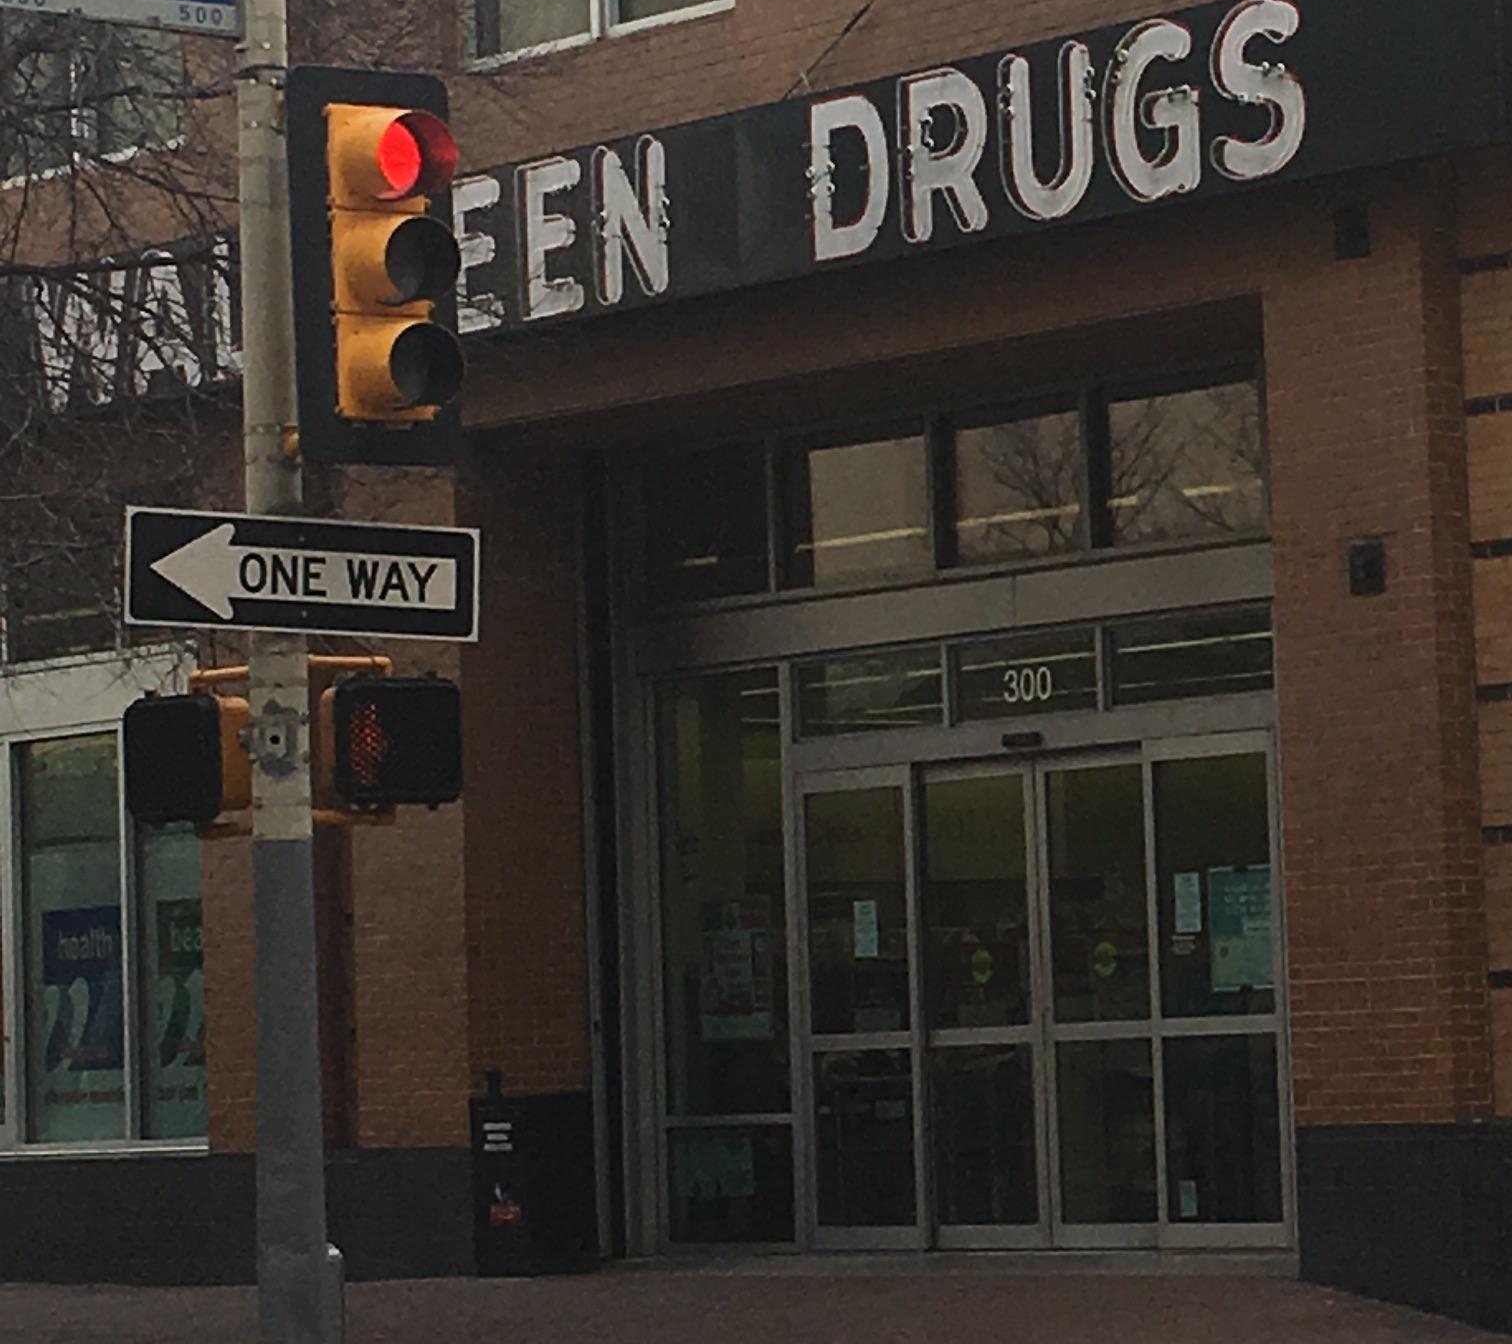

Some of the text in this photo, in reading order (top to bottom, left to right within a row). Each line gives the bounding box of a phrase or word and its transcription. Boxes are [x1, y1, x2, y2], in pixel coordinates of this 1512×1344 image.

[179, 5, 224, 26] 500
[239, 552, 439, 603] ONE WAY
[1002, 665, 1053, 703] 300
[57, 926, 115, 961] health
